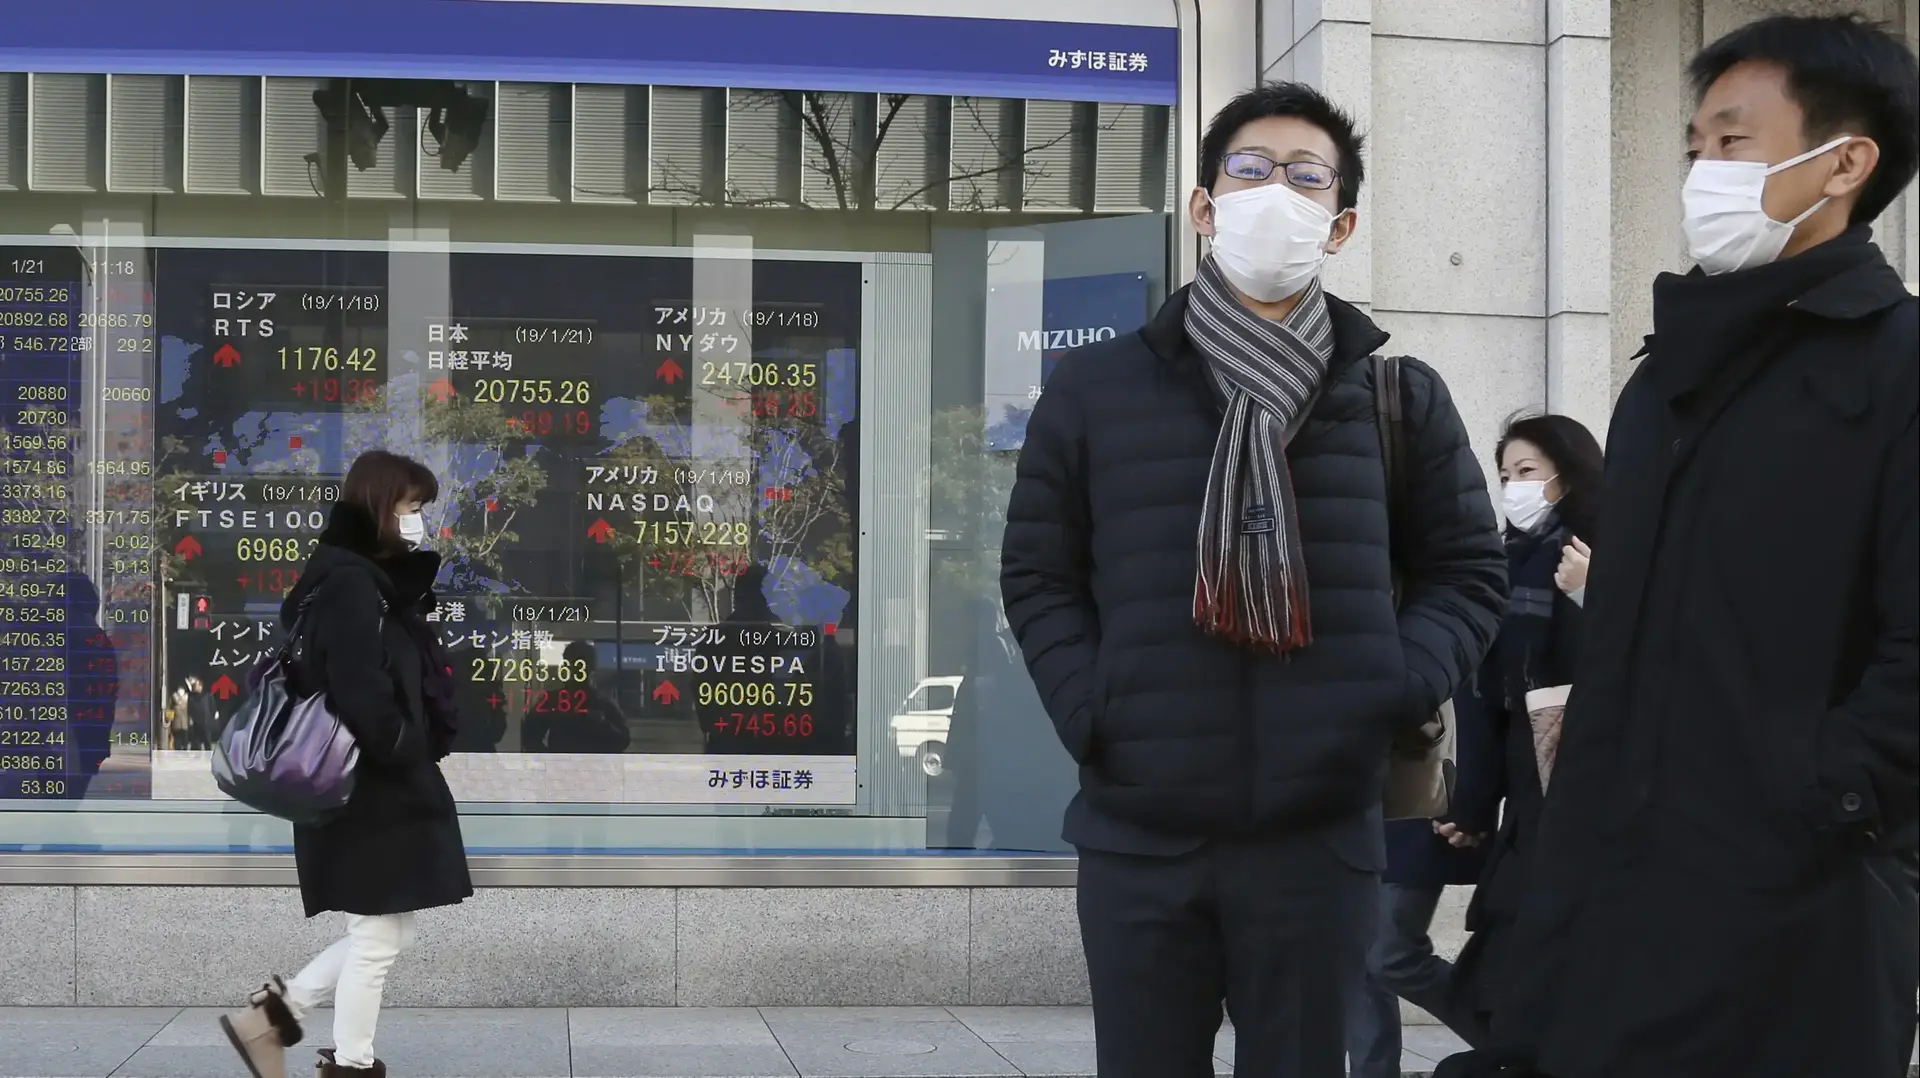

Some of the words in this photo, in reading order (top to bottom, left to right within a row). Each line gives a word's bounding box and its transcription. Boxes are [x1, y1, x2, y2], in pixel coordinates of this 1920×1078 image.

[1048, 49, 1148, 72] みずほ証券
[12, 260, 44, 273] 1/21
[92, 260, 134, 274] 11:18
[213, 292, 276, 310] ロシア
[78, 313, 152, 327] 20686.79
[655, 307, 726, 326] アメリカ
[215, 319, 275, 337] RTS
[428, 323, 469, 343] 日本
[14, 337, 68, 351] 546.72
[656, 333, 738, 354] NYダウ
[1018, 326, 1116, 351] MIZUHO
[278, 347, 377, 371] 1176.42
[428, 351, 513, 371] 日経平均
[702, 361, 817, 387] 24706.35
[18, 386, 67, 400] 20880
[102, 387, 150, 401] 20660
[474, 379, 590, 404] 20755.26
[18, 411, 67, 425] 20730
[3, 436, 67, 449] 1569.56
[3, 460, 67, 474] 1574.86
[88, 461, 150, 475] 1564.95
[585, 465, 658, 485] アメリカ
[2, 485, 66, 499] 3373.16
[174, 481, 246, 502] イギリス
[587, 493, 714, 513] NASDAQ
[2, 510, 66, 523] 3382.72
[86, 511, 150, 524] 3371.75
[176, 510, 323, 528] FTSE100
[13, 535, 66, 548] 152.49
[109, 535, 149, 549] -0.02
[633, 521, 748, 546] 7157.228
[109, 560, 149, 573] -0.13
[108, 609, 149, 623] -0.10
[0, 633, 65, 647] 4706.35
[209, 621, 273, 641] インド
[652, 625, 725, 647] ブラジル
[472, 658, 587, 682] 27263.63
[655, 655, 805, 674] IBOVESPA
[0, 682, 65, 696] 7263.63
[699, 682, 813, 707] 96096.75
[487, 689, 588, 714] +172.82
[714, 713, 813, 737] +745.66
[1, 731, 65, 745] 2122.44
[109, 732, 149, 746] -1.84
[21, 781, 65, 794] 53.80
[708, 769, 814, 789] みずほ証券
